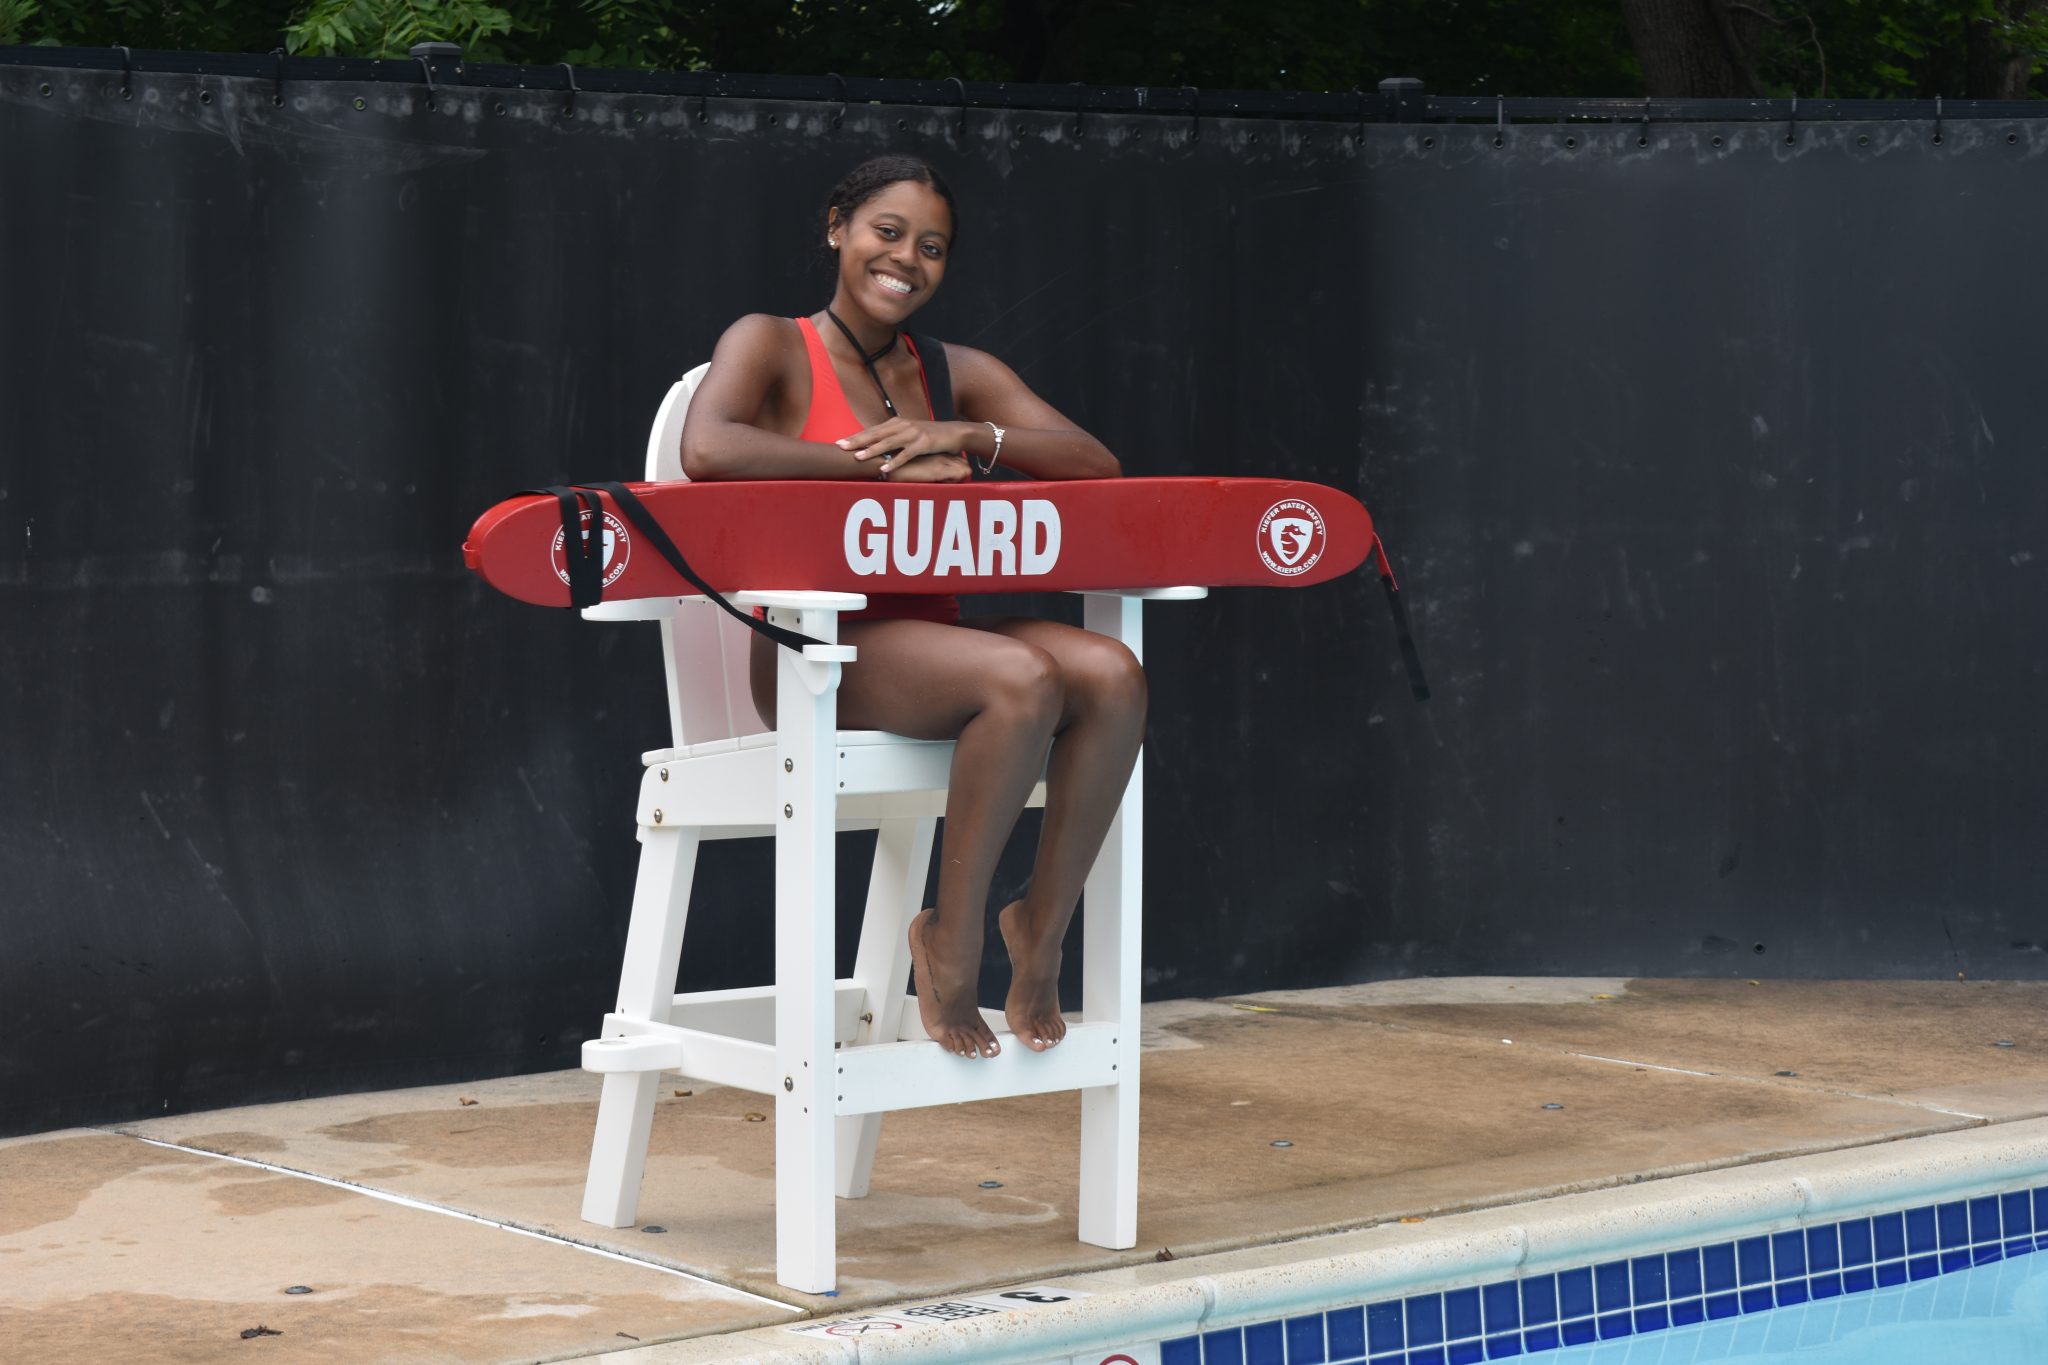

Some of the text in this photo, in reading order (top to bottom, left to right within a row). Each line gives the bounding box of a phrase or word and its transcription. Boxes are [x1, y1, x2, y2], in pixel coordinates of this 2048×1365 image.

[603, 516, 627, 542] SAFETY
[1261, 502, 1324, 535] KIEFER WATER SAFETY
[843, 498, 1062, 576] GUARD
[1262, 550, 1318, 574] WWW.KIEFER.COM
[999, 1291, 1071, 1304] 3
[901, 1303, 974, 1317] DEEP
[922, 1307, 1001, 1322] FEET
